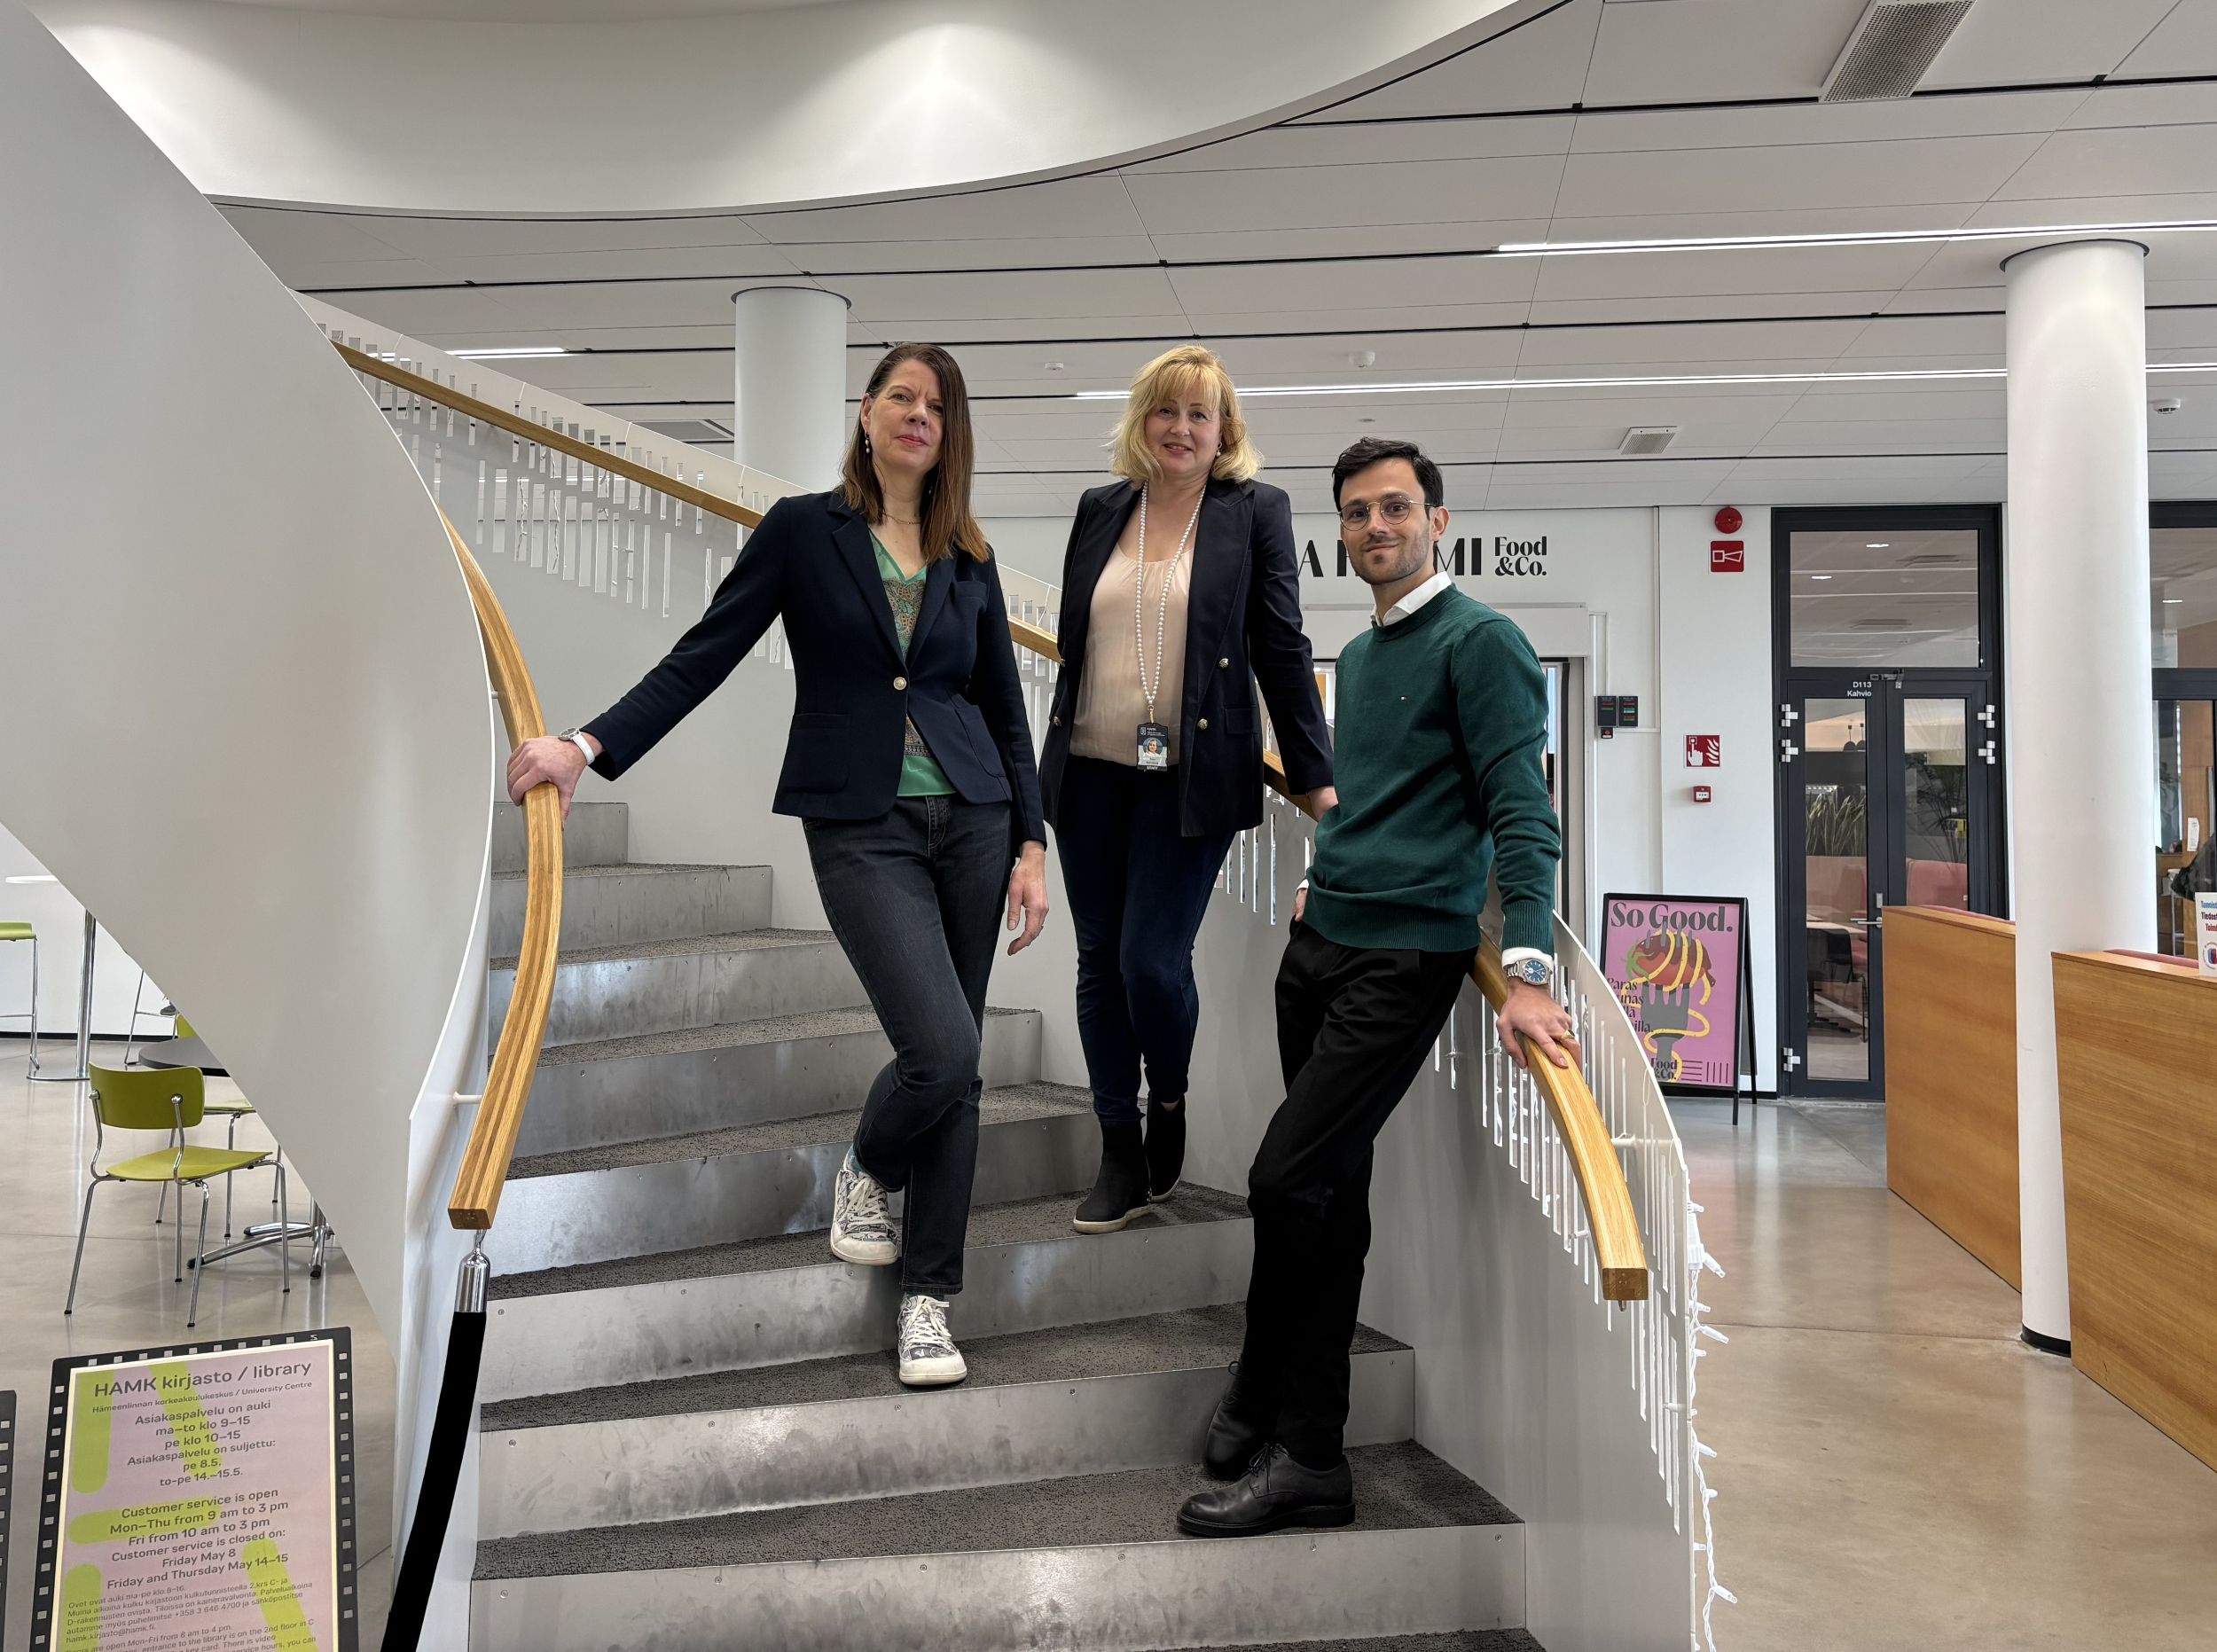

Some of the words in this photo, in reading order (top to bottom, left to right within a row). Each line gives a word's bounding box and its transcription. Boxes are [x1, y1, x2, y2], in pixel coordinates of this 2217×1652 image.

[1495, 536, 1547, 556] Food
[1494, 556, 1547, 576] &Co.
[1611, 902, 1644, 928] So
[1649, 904, 1733, 932] Good.
[1650, 1057, 1678, 1070] Food
[95, 1377, 157, 1397] HAMK
[162, 1372, 232, 1390] kirjasto
[238, 1366, 248, 1381] /
[254, 1363, 311, 1378] library
[92, 1401, 153, 1413] Hämeenlinnan
[154, 1391, 234, 1406] korkeakoulukeskus
[242, 1384, 283, 1396] University
[285, 1382, 312, 1391] Centre
[135, 1406, 224, 1425] Asiakaspalvelu
[228, 1405, 243, 1413] on
[247, 1400, 270, 1412] auki
[155, 1424, 196, 1436] ma–to
[200, 1421, 217, 1430] klo
[221, 1415, 250, 1428] 9–15
[165, 1440, 180, 1451] pe
[184, 1436, 201, 1446] klo
[204, 1429, 241, 1443] 10–15
[127, 1448, 210, 1466] Asiakaspalvelu
[214, 1445, 227, 1454] on
[231, 1439, 276, 1452] suljettu:
[183, 1462, 196, 1472] pe
[200, 1458, 222, 1468] 8.5.
[160, 1476, 191, 1487] to-pe
[194, 1468, 243, 1482] 14.–15.5.
[121, 1503, 184, 1519] Customer
[186, 1496, 231, 1509] service
[235, 1492, 245, 1502] is
[248, 1489, 278, 1501] open
[110, 1518, 170, 1534] Mon–Thu
[175, 1515, 204, 1525] from
[208, 1510, 216, 1520] 9
[220, 1509, 239, 1519] am
[242, 1507, 255, 1515] to
[258, 1503, 266, 1513] 3
[270, 1501, 288, 1514] pm
[129, 1535, 145, 1546] Fri
[149, 1532, 178, 1543] from
[181, 1527, 197, 1538] 10
[200, 1525, 219, 1536] am
[223, 1523, 236, 1532] to
[239, 1520, 247, 1530] 3
[251, 1518, 270, 1531] pm
[112, 1546, 169, 1562] Customer
[172, 1540, 213, 1553] service
[216, 1538, 225, 1546] is
[229, 1531, 265, 1545] closed
[269, 1529, 286, 1538] on:
[162, 1555, 198, 1568] Friday
[200, 1552, 225, 1562] May
[228, 1548, 236, 1558] 8
[107, 1578, 144, 1590] Friday
[146, 1571, 168, 1584] and
[171, 1565, 224, 1579] Thursday
[228, 1561, 253, 1571] May
[255, 1554, 288, 1567] 14–15
[203, 1634, 227, 1644] library
[287, 1639, 301, 1648] you
